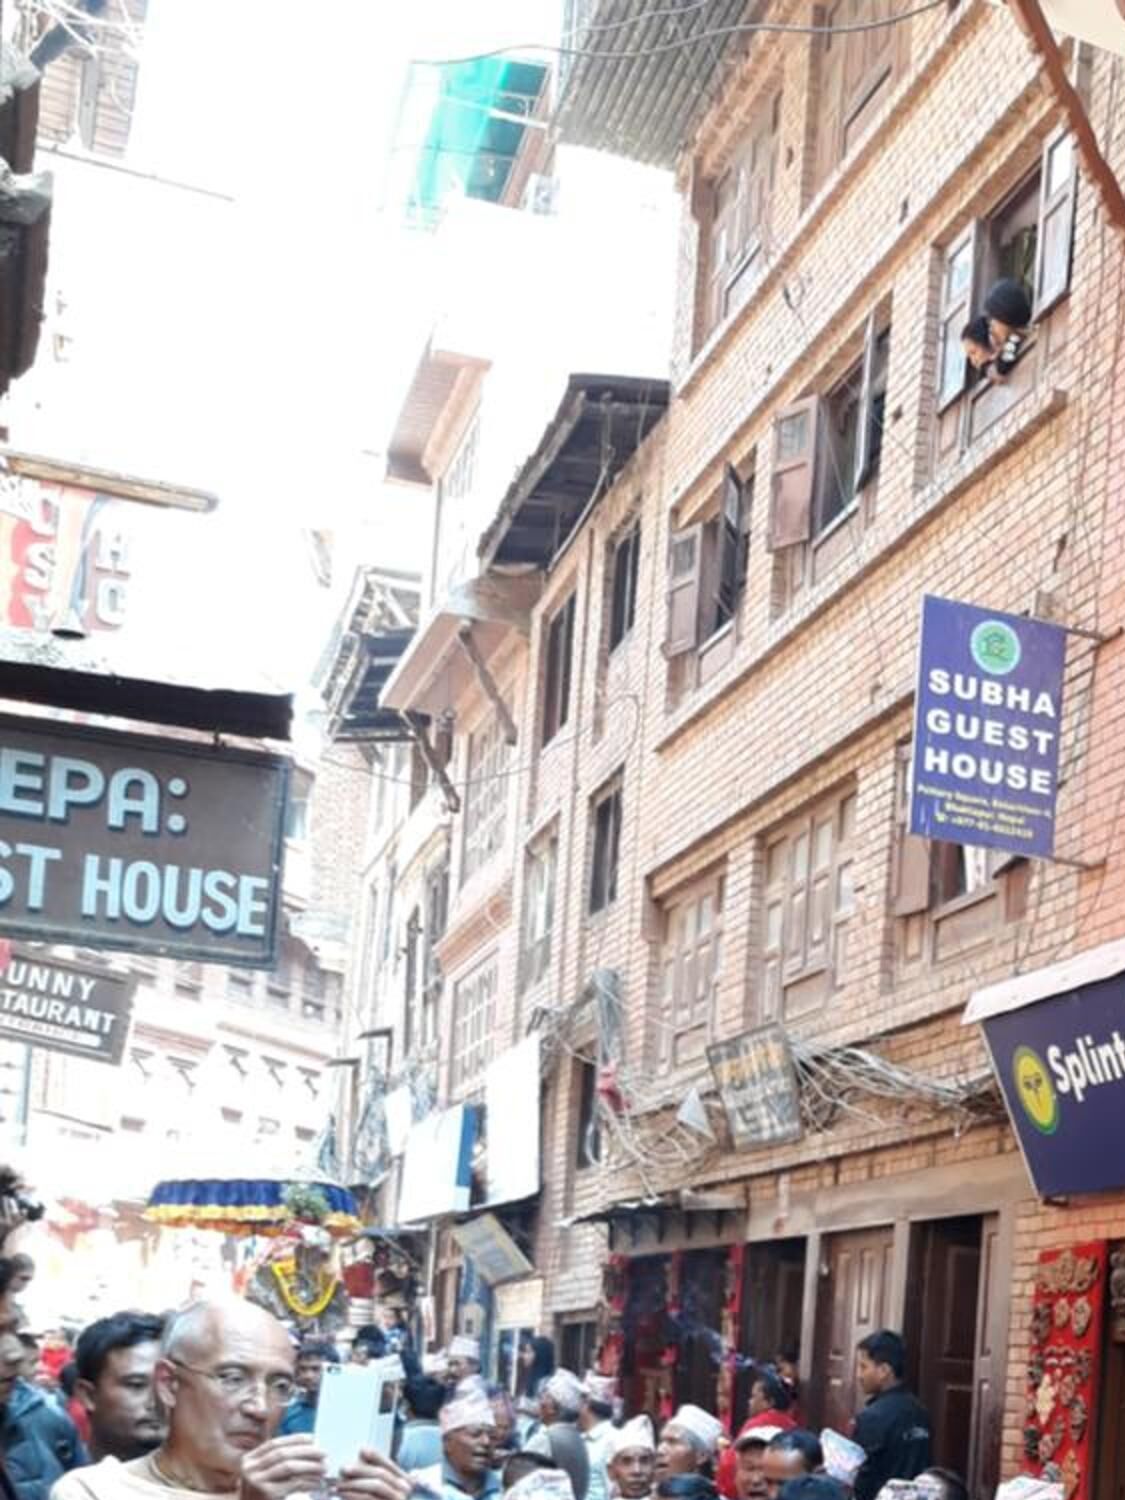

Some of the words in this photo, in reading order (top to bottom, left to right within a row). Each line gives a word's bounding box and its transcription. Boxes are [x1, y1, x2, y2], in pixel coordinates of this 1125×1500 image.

[928, 668, 1056, 718] SUBHA
[926, 708, 1054, 755] GUEST
[0, 747, 187, 833] EPA:
[924, 746, 1052, 794] HOUSE
[82, 853, 268, 936] HOUSE
[0, 961, 96, 1002] UNNY
[0, 989, 117, 1034] TAURANT
